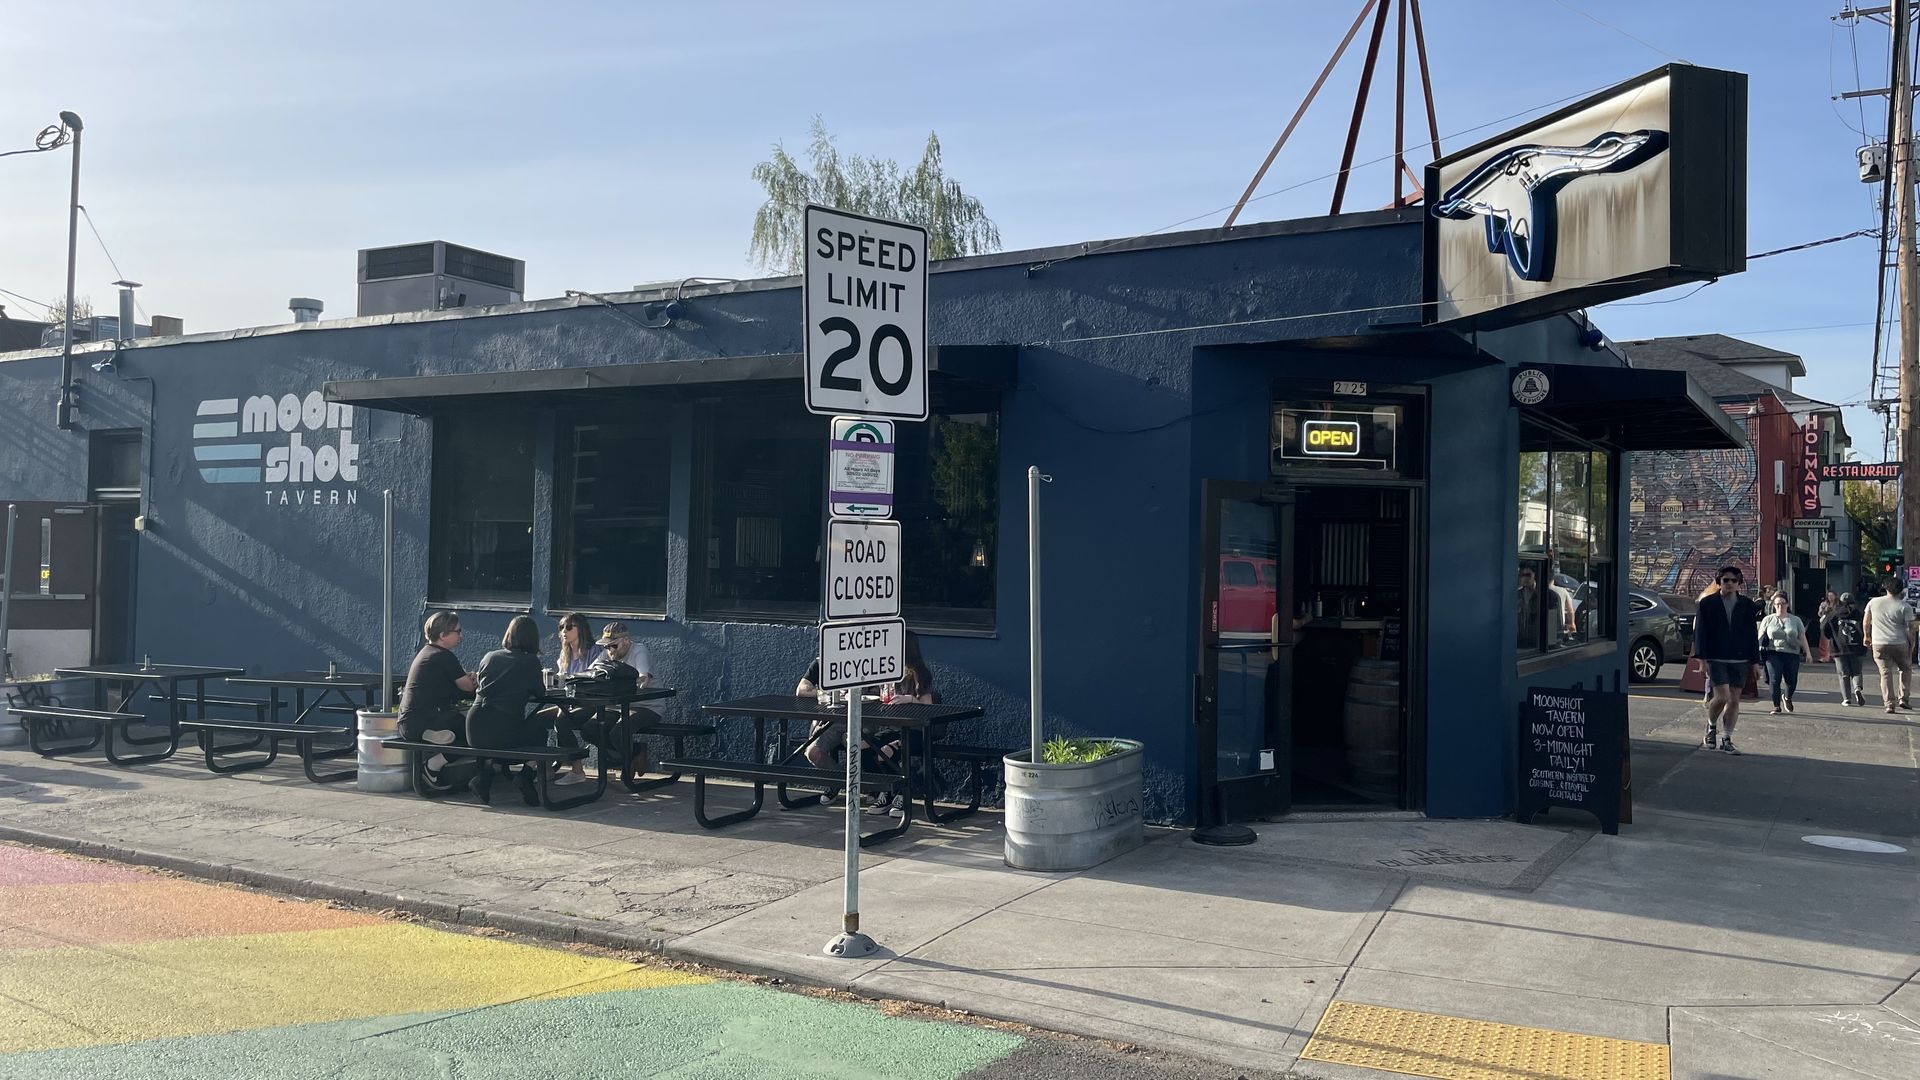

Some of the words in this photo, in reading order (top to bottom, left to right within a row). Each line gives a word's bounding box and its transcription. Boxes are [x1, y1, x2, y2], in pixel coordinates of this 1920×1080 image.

[817, 228, 916, 273] SPEED
[828, 273, 905, 313] LIMIT
[819, 317, 913, 396] 20
[1518, 370, 1544, 379] PUBLIC
[1335, 382, 1366, 394] 2725
[1514, 389, 1547, 403] TELEPHONE
[242, 390, 354, 433] moon
[1309, 430, 1353, 446] OPEN
[265, 430, 359, 483] shot
[1823, 465, 1899, 477] RESTAURANT
[265, 489, 357, 505] TAVERN
[844, 539, 886, 564] ROAD
[834, 575, 894, 601] CLOSED
[839, 628, 889, 651] EXCEPT
[830, 655, 896, 681] BICYCLES
[1533, 694, 1584, 710] MOONSHOT
[1545, 710, 1585, 724] TAVERN
[1532, 722, 1554, 736] NOW
[1557, 725, 1584, 739] OPEN
[1549, 755, 1585, 773] DAILY!
[1532, 768, 1564, 780] SOUTHERN
[1566, 773, 1596, 783] INSPIRED
[1548, 789, 1583, 801] COCKTAILS
